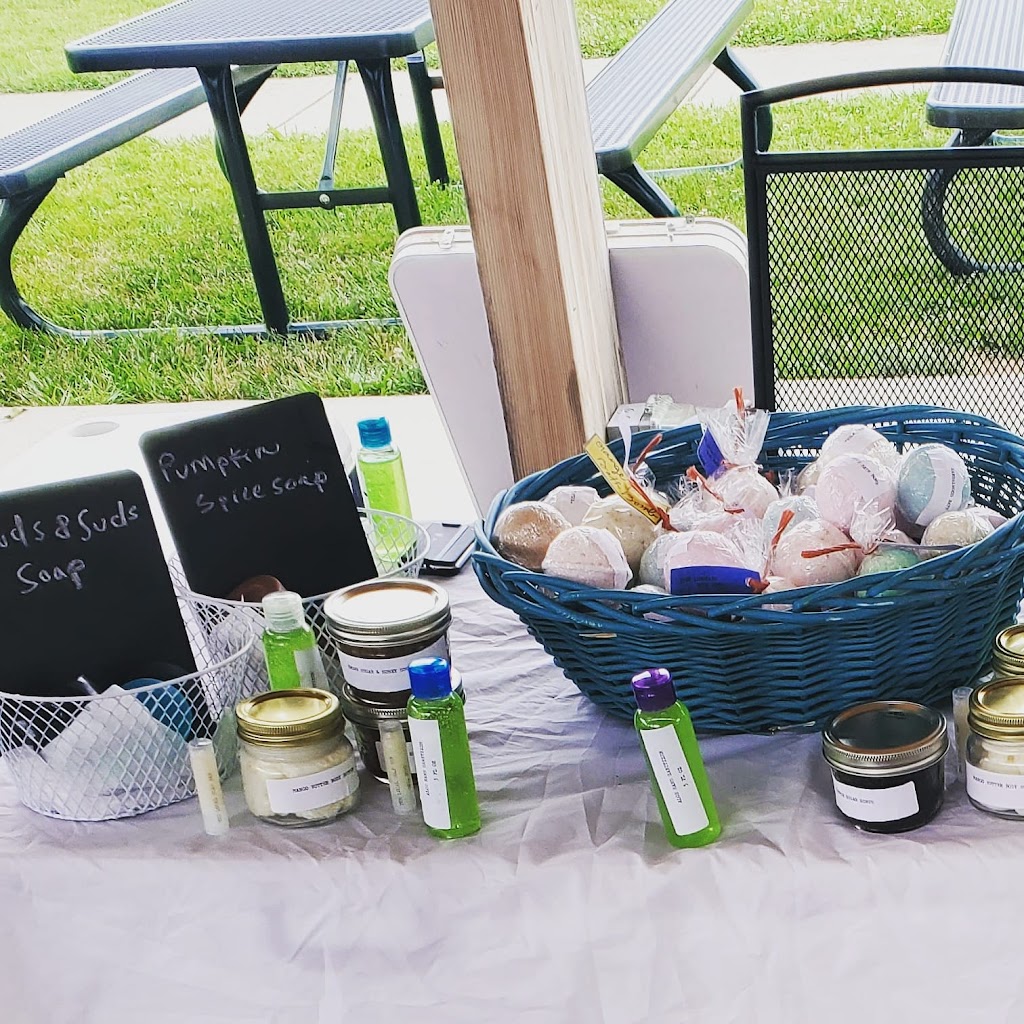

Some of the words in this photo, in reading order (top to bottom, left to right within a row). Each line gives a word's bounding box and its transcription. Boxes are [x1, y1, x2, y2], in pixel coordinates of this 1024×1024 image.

[158, 443, 280, 482] Pumpkin
[196, 484, 266, 514] Spice
[0, 514, 45, 548] uds
[77, 500, 139, 541] Suds
[16, 559, 86, 594] Soap
